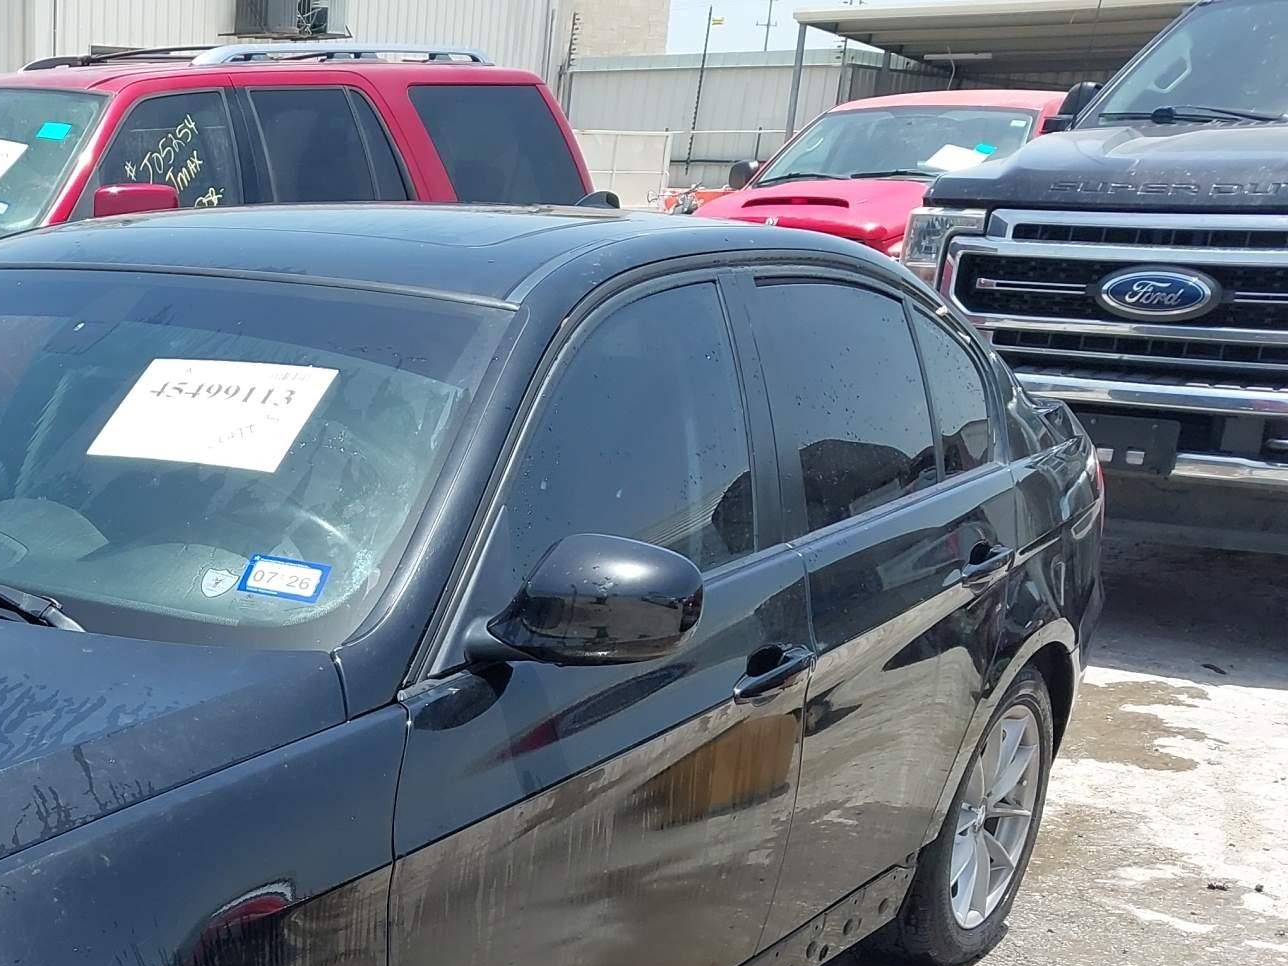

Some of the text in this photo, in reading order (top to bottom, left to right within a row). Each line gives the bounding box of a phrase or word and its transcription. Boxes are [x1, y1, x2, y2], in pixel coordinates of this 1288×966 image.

[1049, 182, 1201, 197] SUPER
[1124, 280, 1185, 306] Ford
[150, 381, 296, 406] 45499113
